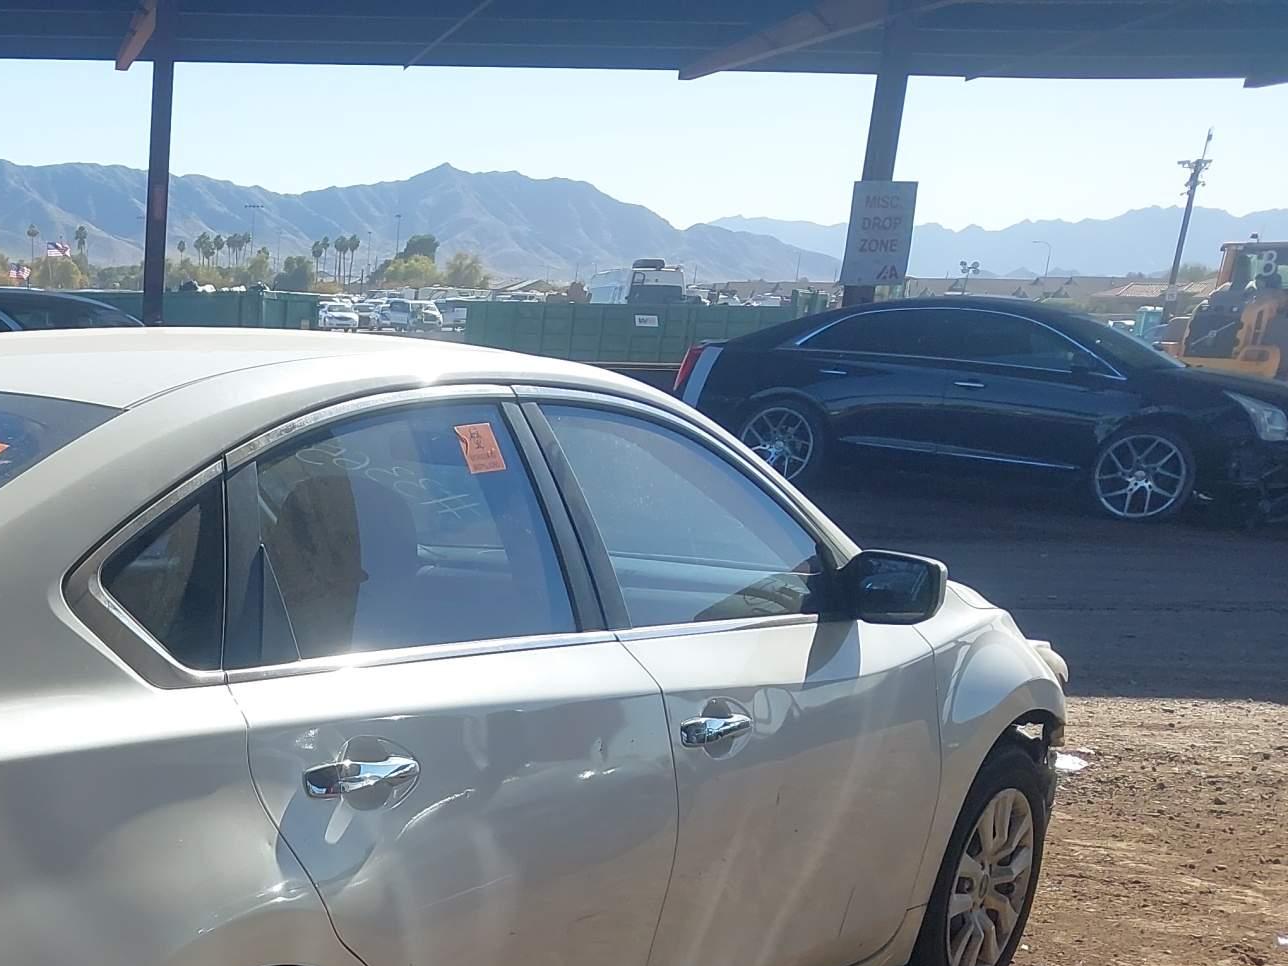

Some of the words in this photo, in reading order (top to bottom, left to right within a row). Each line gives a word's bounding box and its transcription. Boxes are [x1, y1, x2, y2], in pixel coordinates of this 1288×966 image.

[864, 195, 903, 209] MISC.
[861, 216, 902, 231] DROP
[858, 238, 898, 253] ZONE
